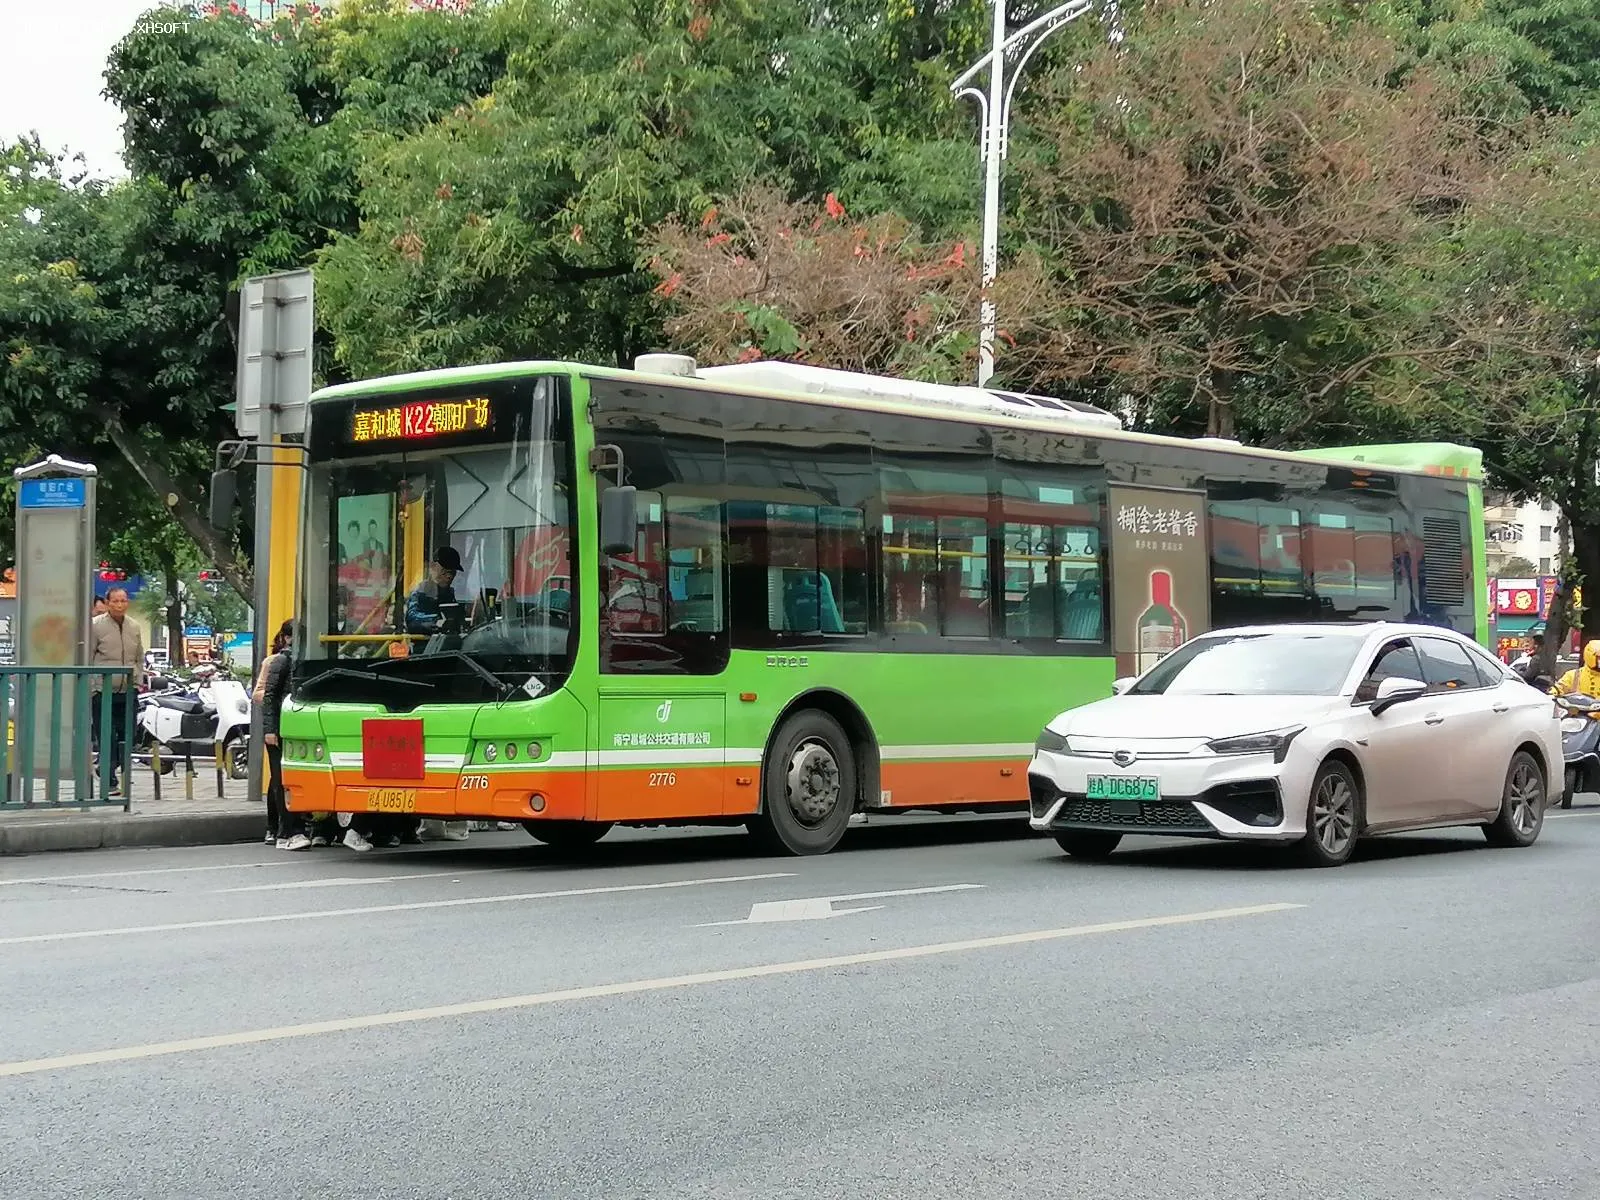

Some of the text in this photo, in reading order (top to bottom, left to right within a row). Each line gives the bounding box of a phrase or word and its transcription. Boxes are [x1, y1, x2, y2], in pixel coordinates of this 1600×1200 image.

[354, 398, 489, 440] 嘉和城 K22 朝阳广场
[461, 775, 488, 790] 2776
[649, 772, 676, 787] 2776
